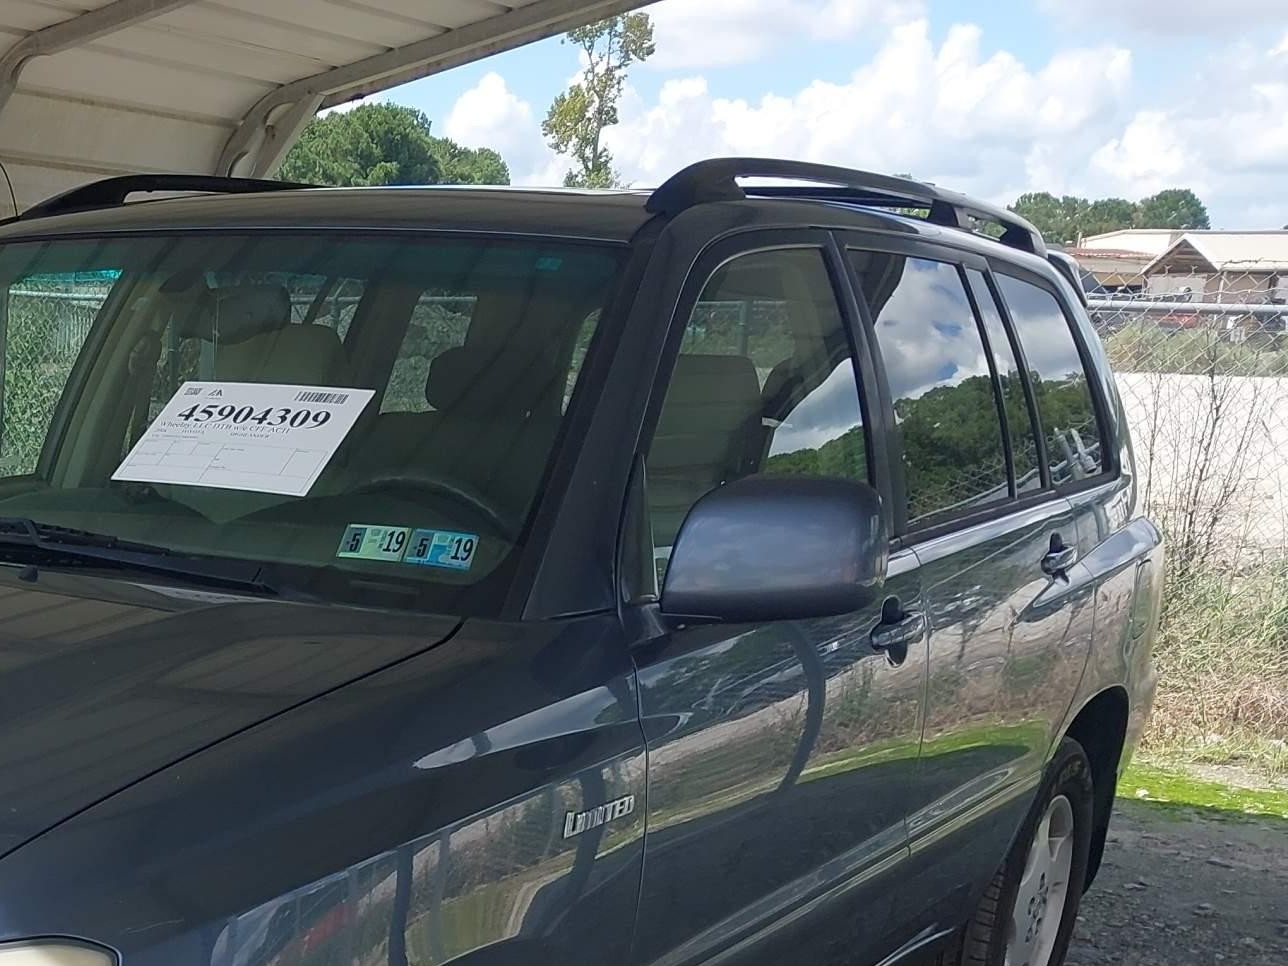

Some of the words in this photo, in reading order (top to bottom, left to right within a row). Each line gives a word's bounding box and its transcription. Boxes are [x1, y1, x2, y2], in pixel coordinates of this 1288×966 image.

[178, 403, 332, 430] 45904309
[382, 531, 406, 554] 19
[450, 538, 474, 562] 19
